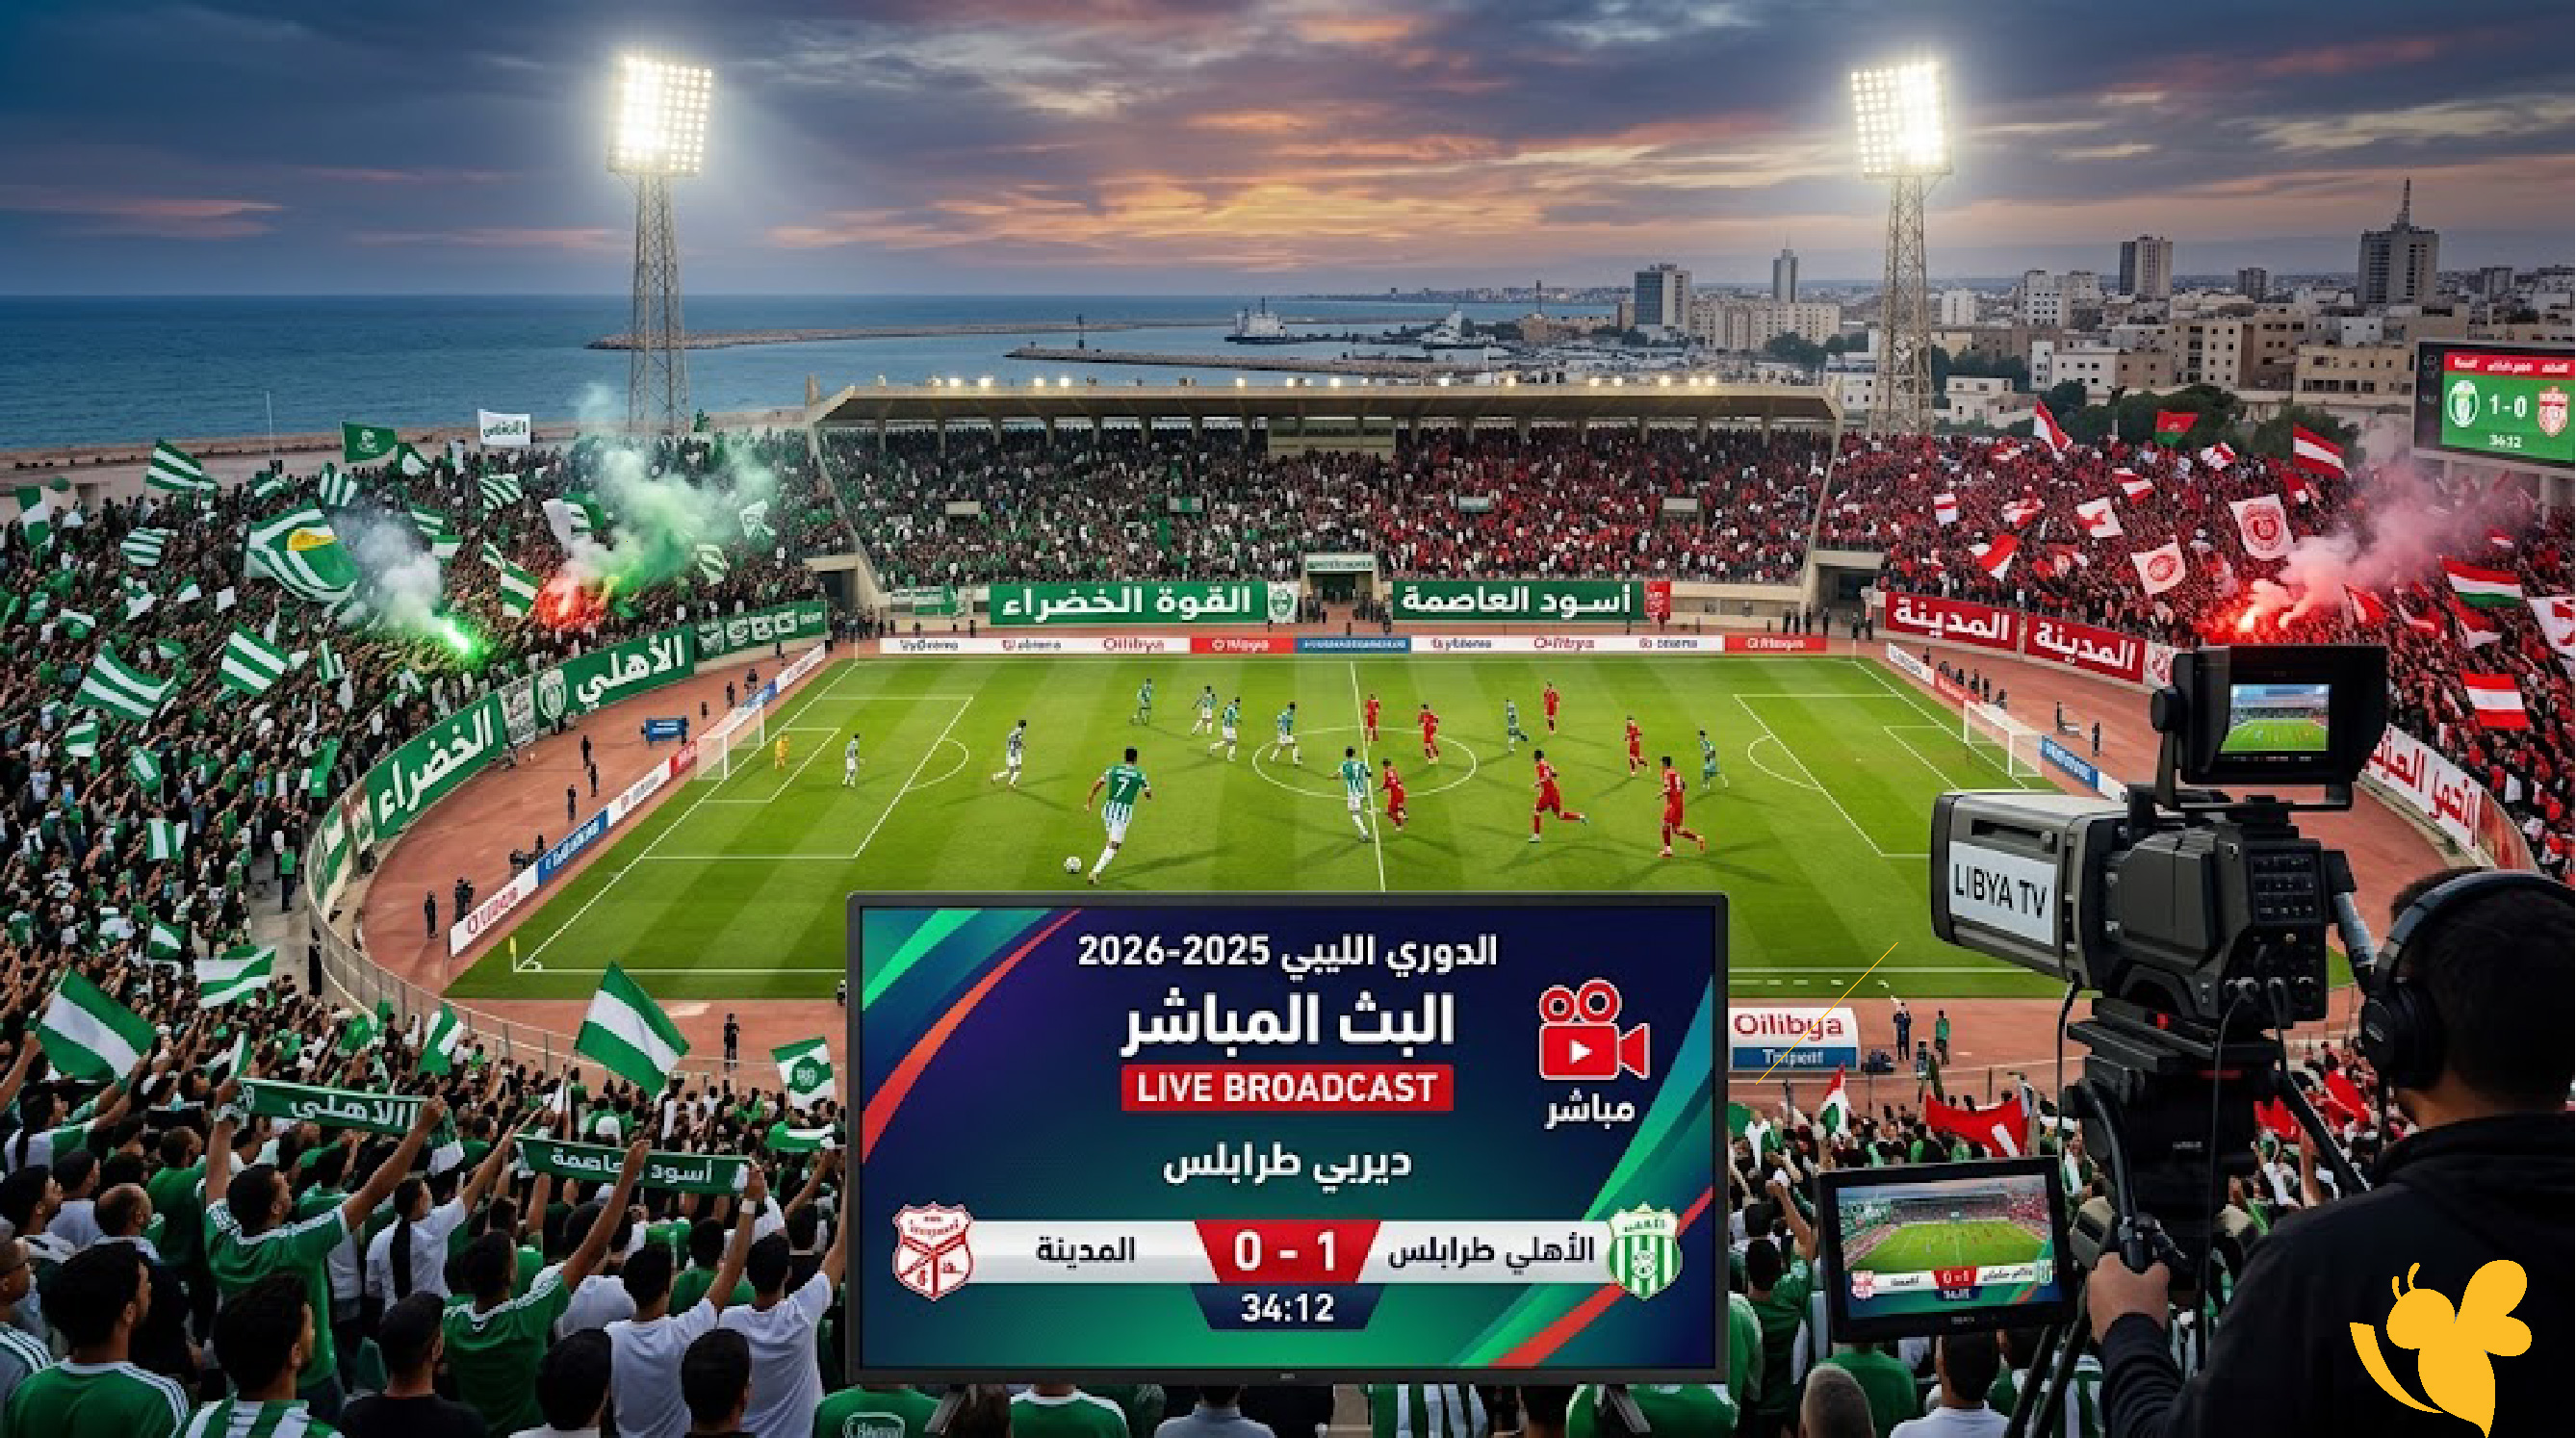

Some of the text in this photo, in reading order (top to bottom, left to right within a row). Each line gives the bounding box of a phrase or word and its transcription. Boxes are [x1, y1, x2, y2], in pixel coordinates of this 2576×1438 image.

[1002, 585, 1250, 623] القوة الخضراء
[1401, 585, 1530, 612] العاصمة
[1539, 583, 1631, 618] أسود
[1895, 596, 2010, 640] المدينة
[2036, 622, 2136, 670] المدينة
[378, 706, 494, 823] الخضراء
[1115, 778, 1130, 798] 7
[1954, 863, 2048, 918] LIBYA TV
[1281, 934, 1377, 982] الليبي
[1386, 934, 1497, 978] الدوري
[1120, 987, 1455, 1057] البث المباشر
[1733, 1013, 1843, 1041] Oilibya
[1138, 1071, 1438, 1102] LIVE BROADCAST
[1544, 1088, 1636, 1130] مباشر
[651, 1159, 713, 1184] أسود
[1163, 1141, 1412, 1194] ديربي طرابلس
[1036, 1235, 1135, 1270] المدينة
[1233, 1230, 1261, 1271] 0
[1317, 1230, 1336, 1271] 1
[1387, 1231, 1595, 1275] الأهلي طرابلس
[1240, 1292, 1335, 1323] 34:12
